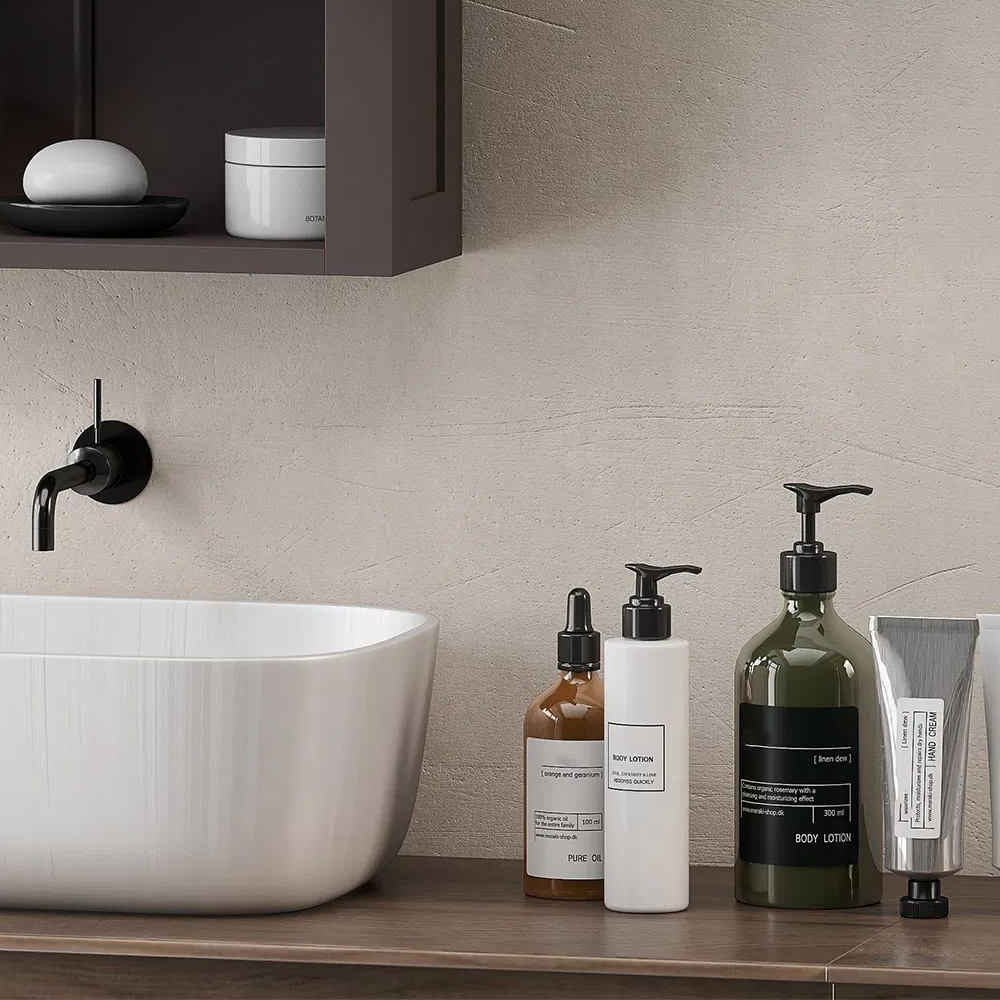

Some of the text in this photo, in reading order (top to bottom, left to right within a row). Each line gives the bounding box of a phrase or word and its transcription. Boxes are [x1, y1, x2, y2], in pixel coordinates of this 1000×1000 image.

[928, 711, 937, 737] CREAM
[927, 741, 936, 762] HAND
[767, 794, 798, 803] moisturizing
[795, 832, 852, 843] BODY LOTION
